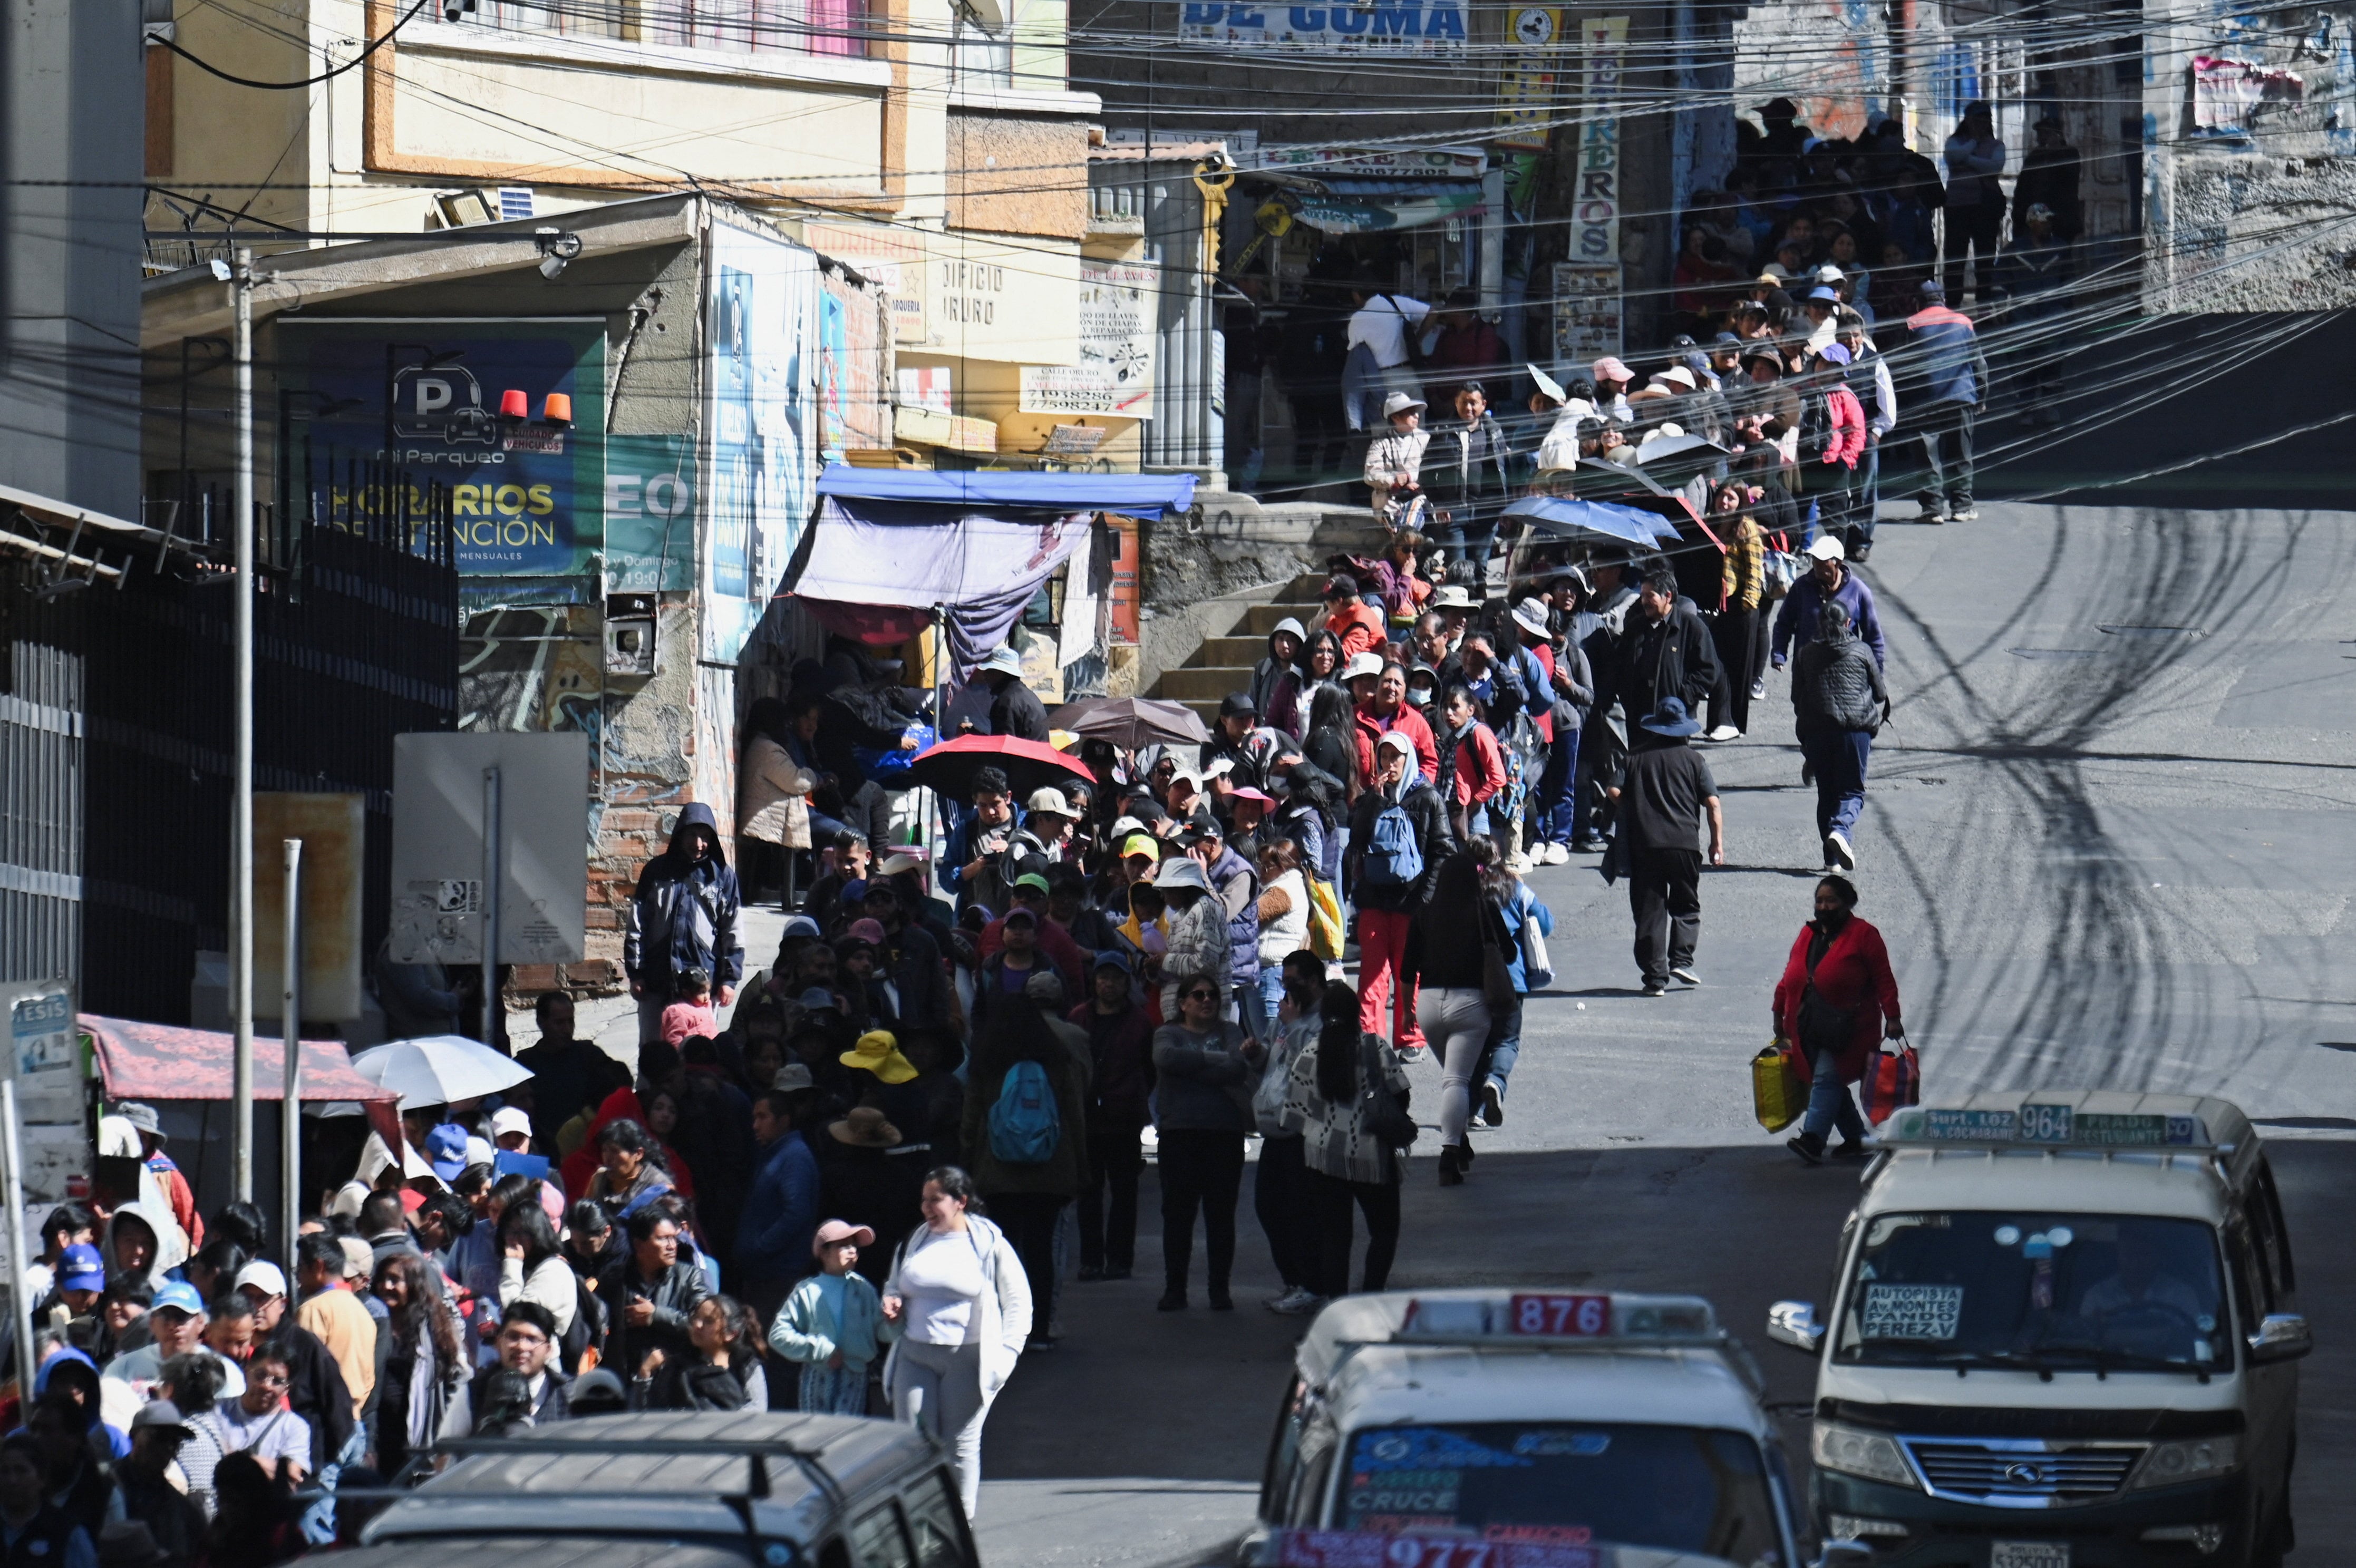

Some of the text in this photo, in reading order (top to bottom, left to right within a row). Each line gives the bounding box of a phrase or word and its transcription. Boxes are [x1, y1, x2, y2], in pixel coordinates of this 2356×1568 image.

[1184, 0, 1265, 28] DE
[1289, 0, 1466, 40] GOMA
[1579, 30, 1619, 256] LETREROS
[1266, 148, 1479, 167] LETREROS
[1349, 167, 1449, 176] 70677505
[808, 226, 920, 260] VIDRIERIA
[416, 378, 452, 428] P
[1028, 400, 1111, 412] 77598247
[406, 450, 506, 468] Parqueo
[624, 555, 679, 569] Domingo
[2021, 1107, 2068, 1141] 964
[1871, 1288, 1957, 1300] AUTOPISTA
[1519, 1298, 1604, 1335] 876
[1867, 1312, 1954, 1322] PANDO
[1348, 1492, 1457, 1510] CRUCE
